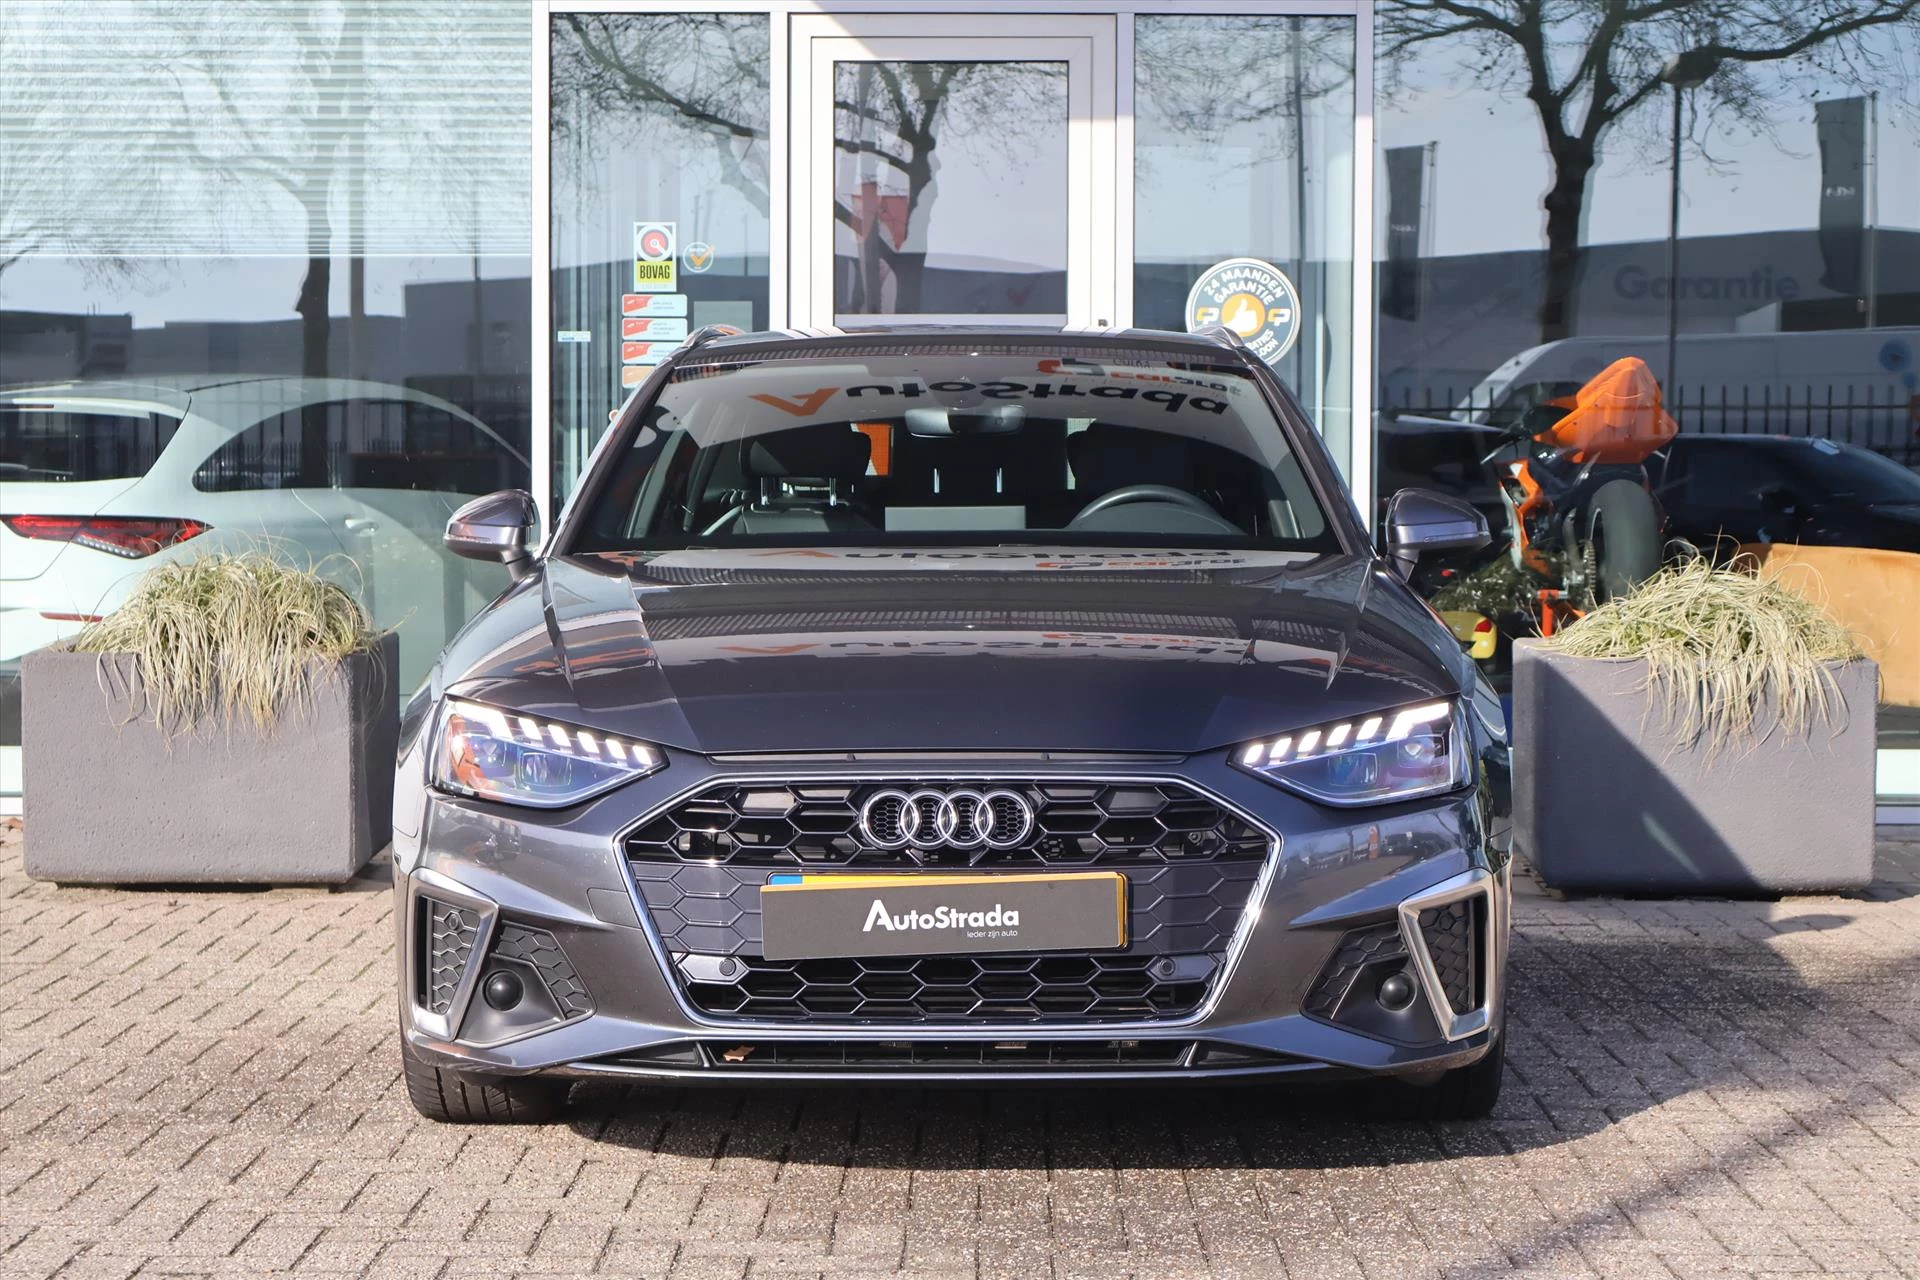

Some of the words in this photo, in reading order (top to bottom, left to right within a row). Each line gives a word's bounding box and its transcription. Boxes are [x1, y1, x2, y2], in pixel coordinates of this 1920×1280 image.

[640, 265, 670, 279] BOVAG
[1204, 279, 1220, 295] 24
[1221, 268, 1285, 298] MAANDEN
[1613, 264, 1800, 300] Garantie
[1214, 281, 1275, 305] GARANTIE
[863, 899, 1019, 932] AutoStrada
